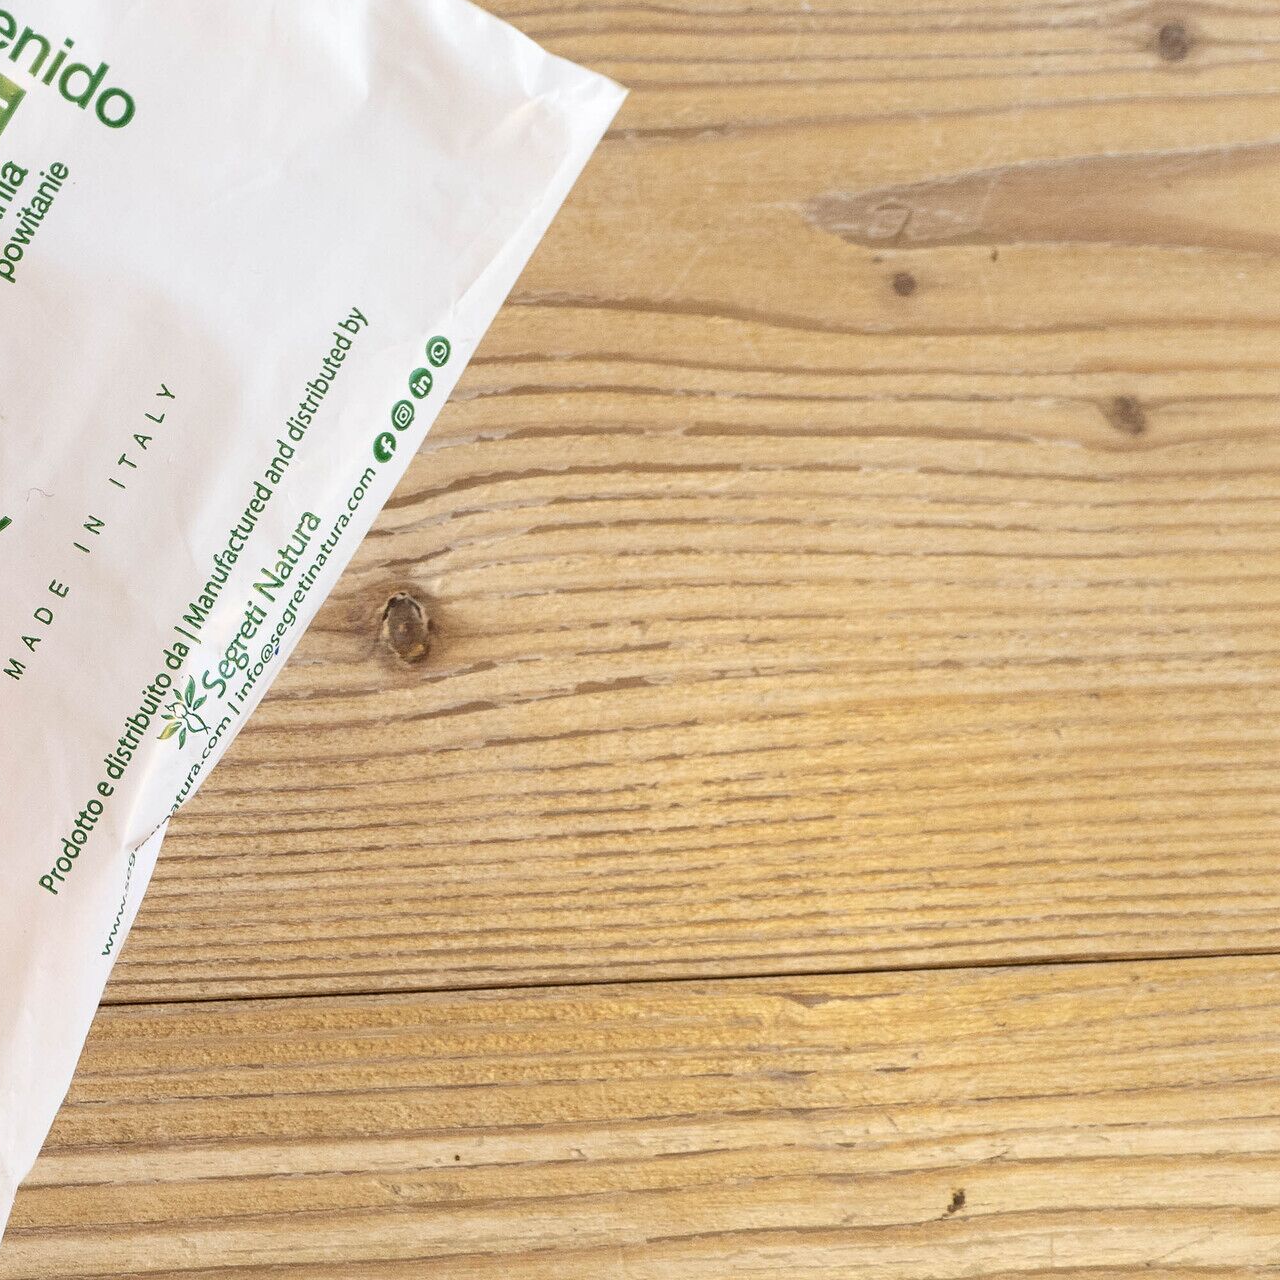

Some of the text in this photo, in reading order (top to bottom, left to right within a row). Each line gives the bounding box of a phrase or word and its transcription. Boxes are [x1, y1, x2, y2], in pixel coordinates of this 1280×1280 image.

[338, 307, 368, 334] by
[286, 332, 353, 441] distributed
[265, 439, 295, 484] and
[3, 384, 175, 680] MADE IN ITALY
[183, 481, 273, 630] Manufactured
[235, 468, 376, 702] info@segretinatura.com
[163, 642, 190, 670] da
[201, 512, 321, 698] Segreti Natura
[104, 672, 172, 779] distribuito
[97, 781, 114, 797] e
[39, 799, 104, 895] Prodotto
